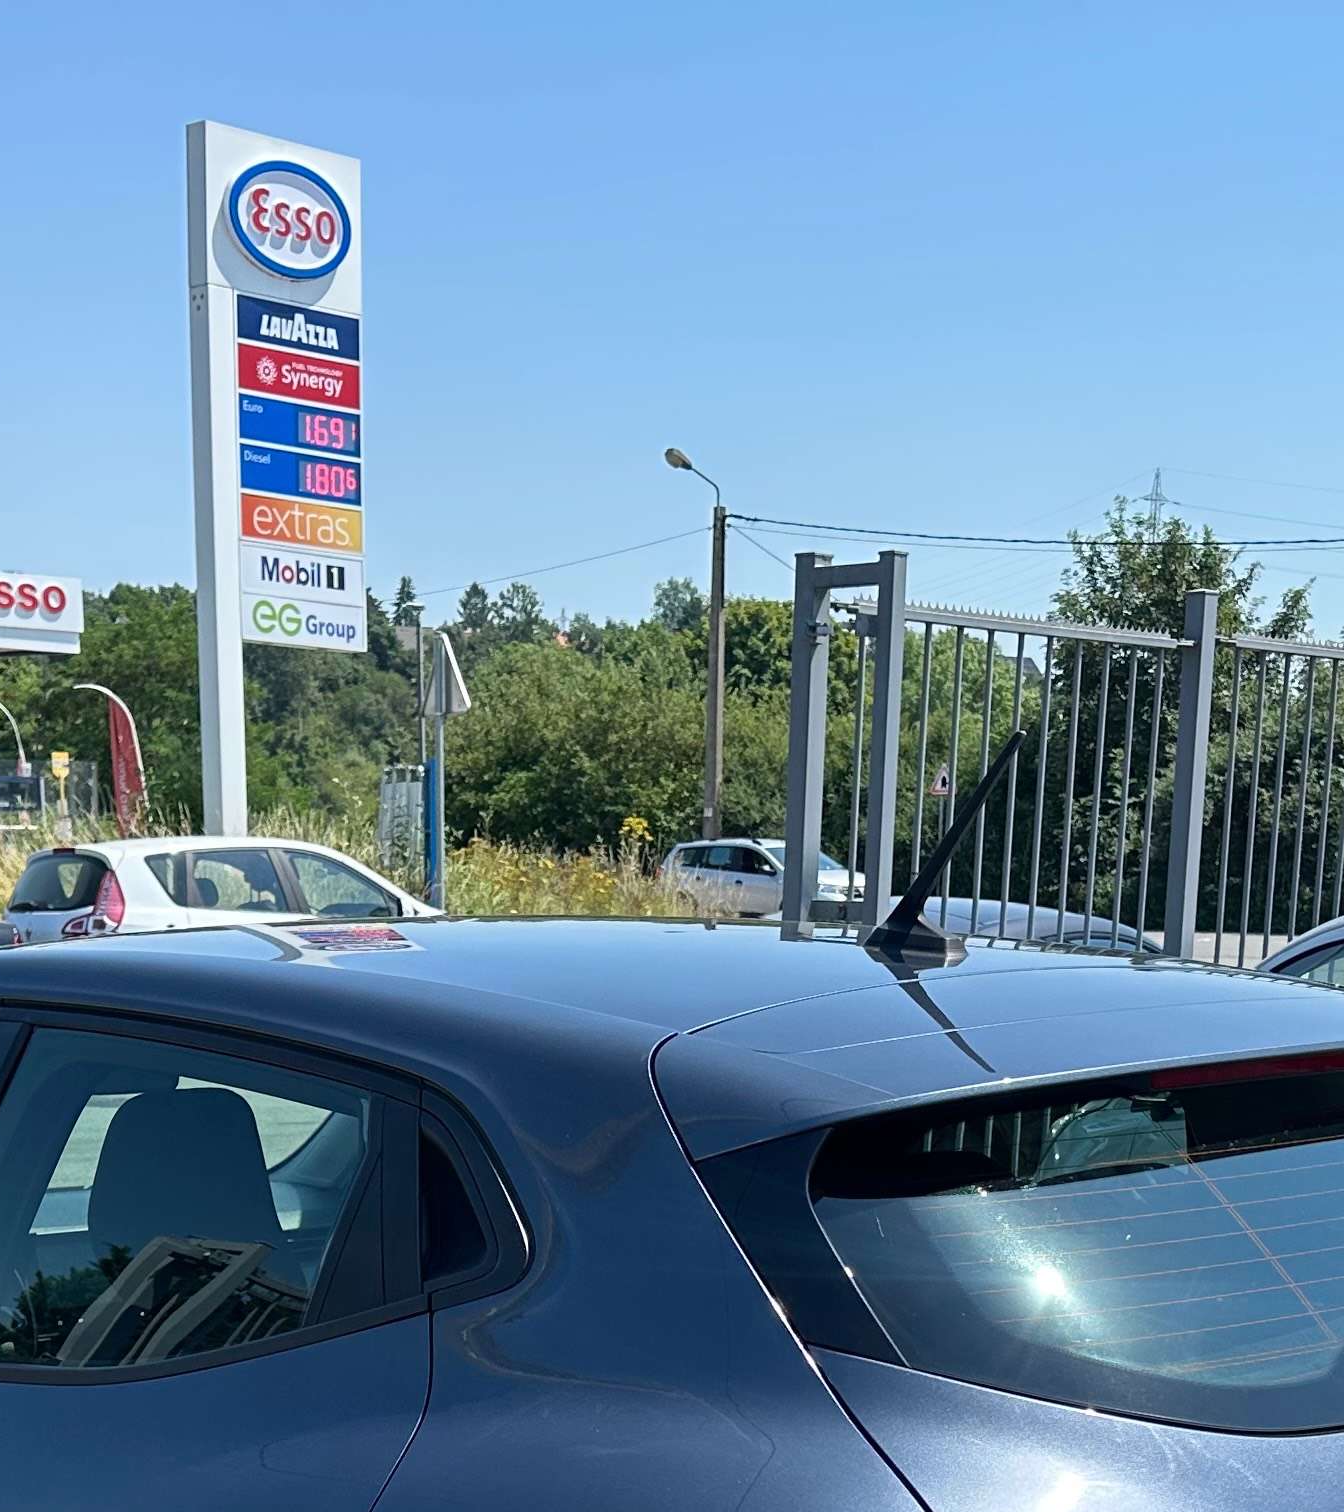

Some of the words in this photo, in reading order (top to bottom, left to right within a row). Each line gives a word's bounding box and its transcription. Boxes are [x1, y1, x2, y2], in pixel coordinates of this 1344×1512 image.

[259, 313, 339, 350] LAVAZZA
[281, 364, 343, 398] Synergy
[242, 400, 264, 414] Euro
[244, 450, 271, 465] Diesel
[252, 503, 351, 546] extras
[261, 556, 321, 588] Mobil
[328, 566, 343, 590] 1
[306, 615, 356, 643] Group
